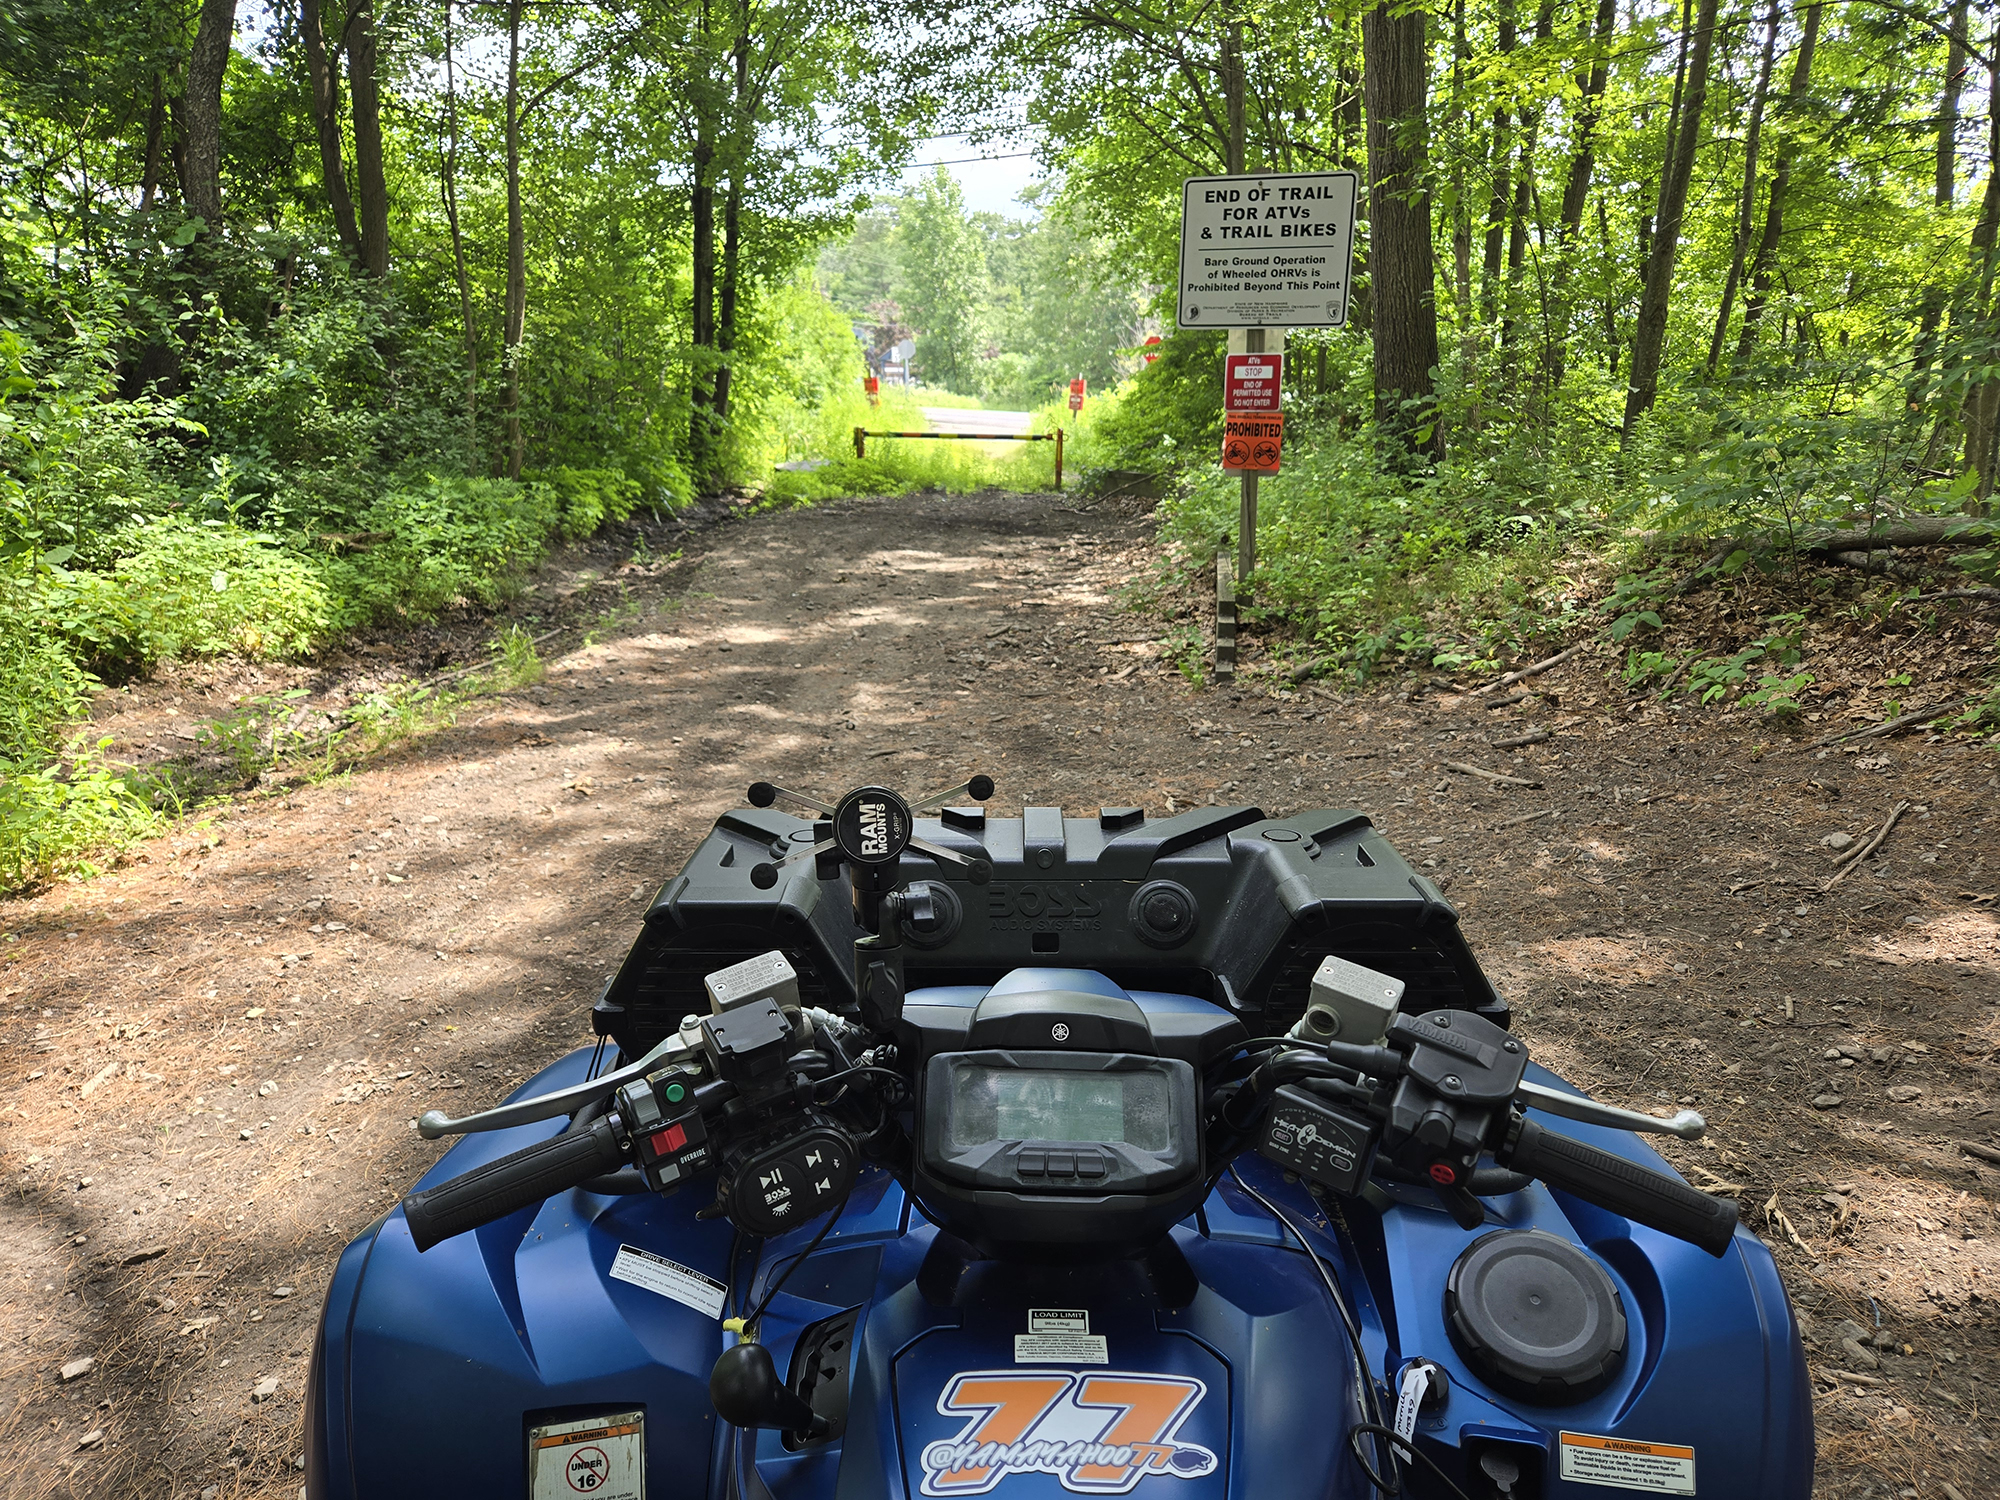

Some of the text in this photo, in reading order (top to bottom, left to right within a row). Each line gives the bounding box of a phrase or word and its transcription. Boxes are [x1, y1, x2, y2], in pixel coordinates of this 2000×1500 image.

[1205, 187, 1333, 203] END OF TRAIL
[1223, 206, 1310, 220] FOR ATVs
[1200, 223, 1336, 239] & TRAIL BIKES
[1204, 255, 1326, 266] Bare Ground Operation
[1208, 268, 1320, 279] of Wheeled OHRVs is
[1188, 281, 1340, 292] Prohibited Beyond This Point
[1245, 368, 1262, 376] STOP
[1226, 422, 1281, 437] PROHIBITED
[859, 804, 878, 855] RAM
[876, 804, 888, 854] MOUNTS
[989, 884, 1102, 918] BOSS
[990, 920, 1101, 931] AUDIO SYSTEMS
[1407, 1018, 1469, 1050] YAMAHA
[680, 1148, 706, 1164] OVERRIDE
[765, 1186, 790, 1202] BOSS
[640, 1251, 708, 1282] DRIVE SELECT LEVER
[571, 1430, 608, 1441] WARNING
[935, 1379, 1197, 1486] 77
[1611, 1442, 1650, 1453] WARNING
[571, 1460, 602, 1471] UNDER
[577, 1474, 596, 1488] 16
